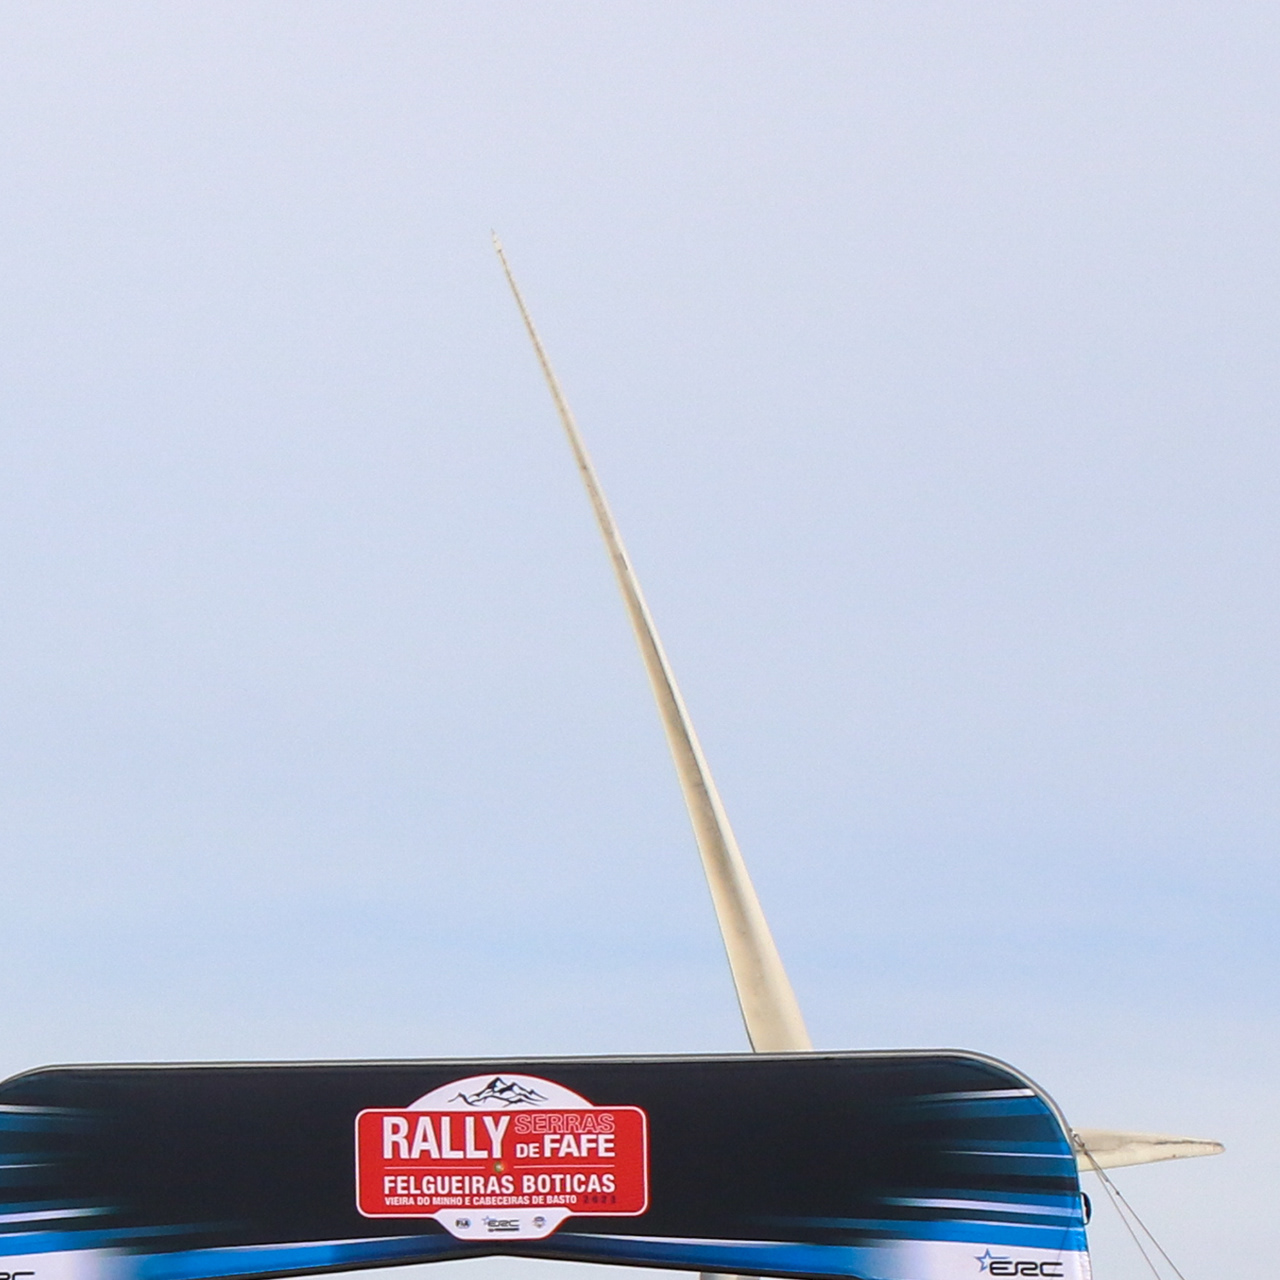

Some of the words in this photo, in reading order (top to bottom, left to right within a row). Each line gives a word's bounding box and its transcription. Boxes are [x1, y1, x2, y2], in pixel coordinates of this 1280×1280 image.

[382, 1115, 511, 1160] RALLY
[514, 1113, 616, 1135] SERRAS
[515, 1143, 540, 1159] DE
[543, 1134, 616, 1159] FAFE
[383, 1174, 515, 1196] FELGUEIRAS
[522, 1173, 616, 1194] BOTICAS
[385, 1196, 415, 1206] VIEIRA
[416, 1196, 430, 1206] DO
[432, 1196, 463, 1206] MINHO
[465, 1196, 471, 1205] E
[473, 1195, 530, 1206] CABECEIRAS
[532, 1195, 544, 1205] DE
[546, 1194, 577, 1205] BASTO
[990, 1261, 1064, 1278] ERC
